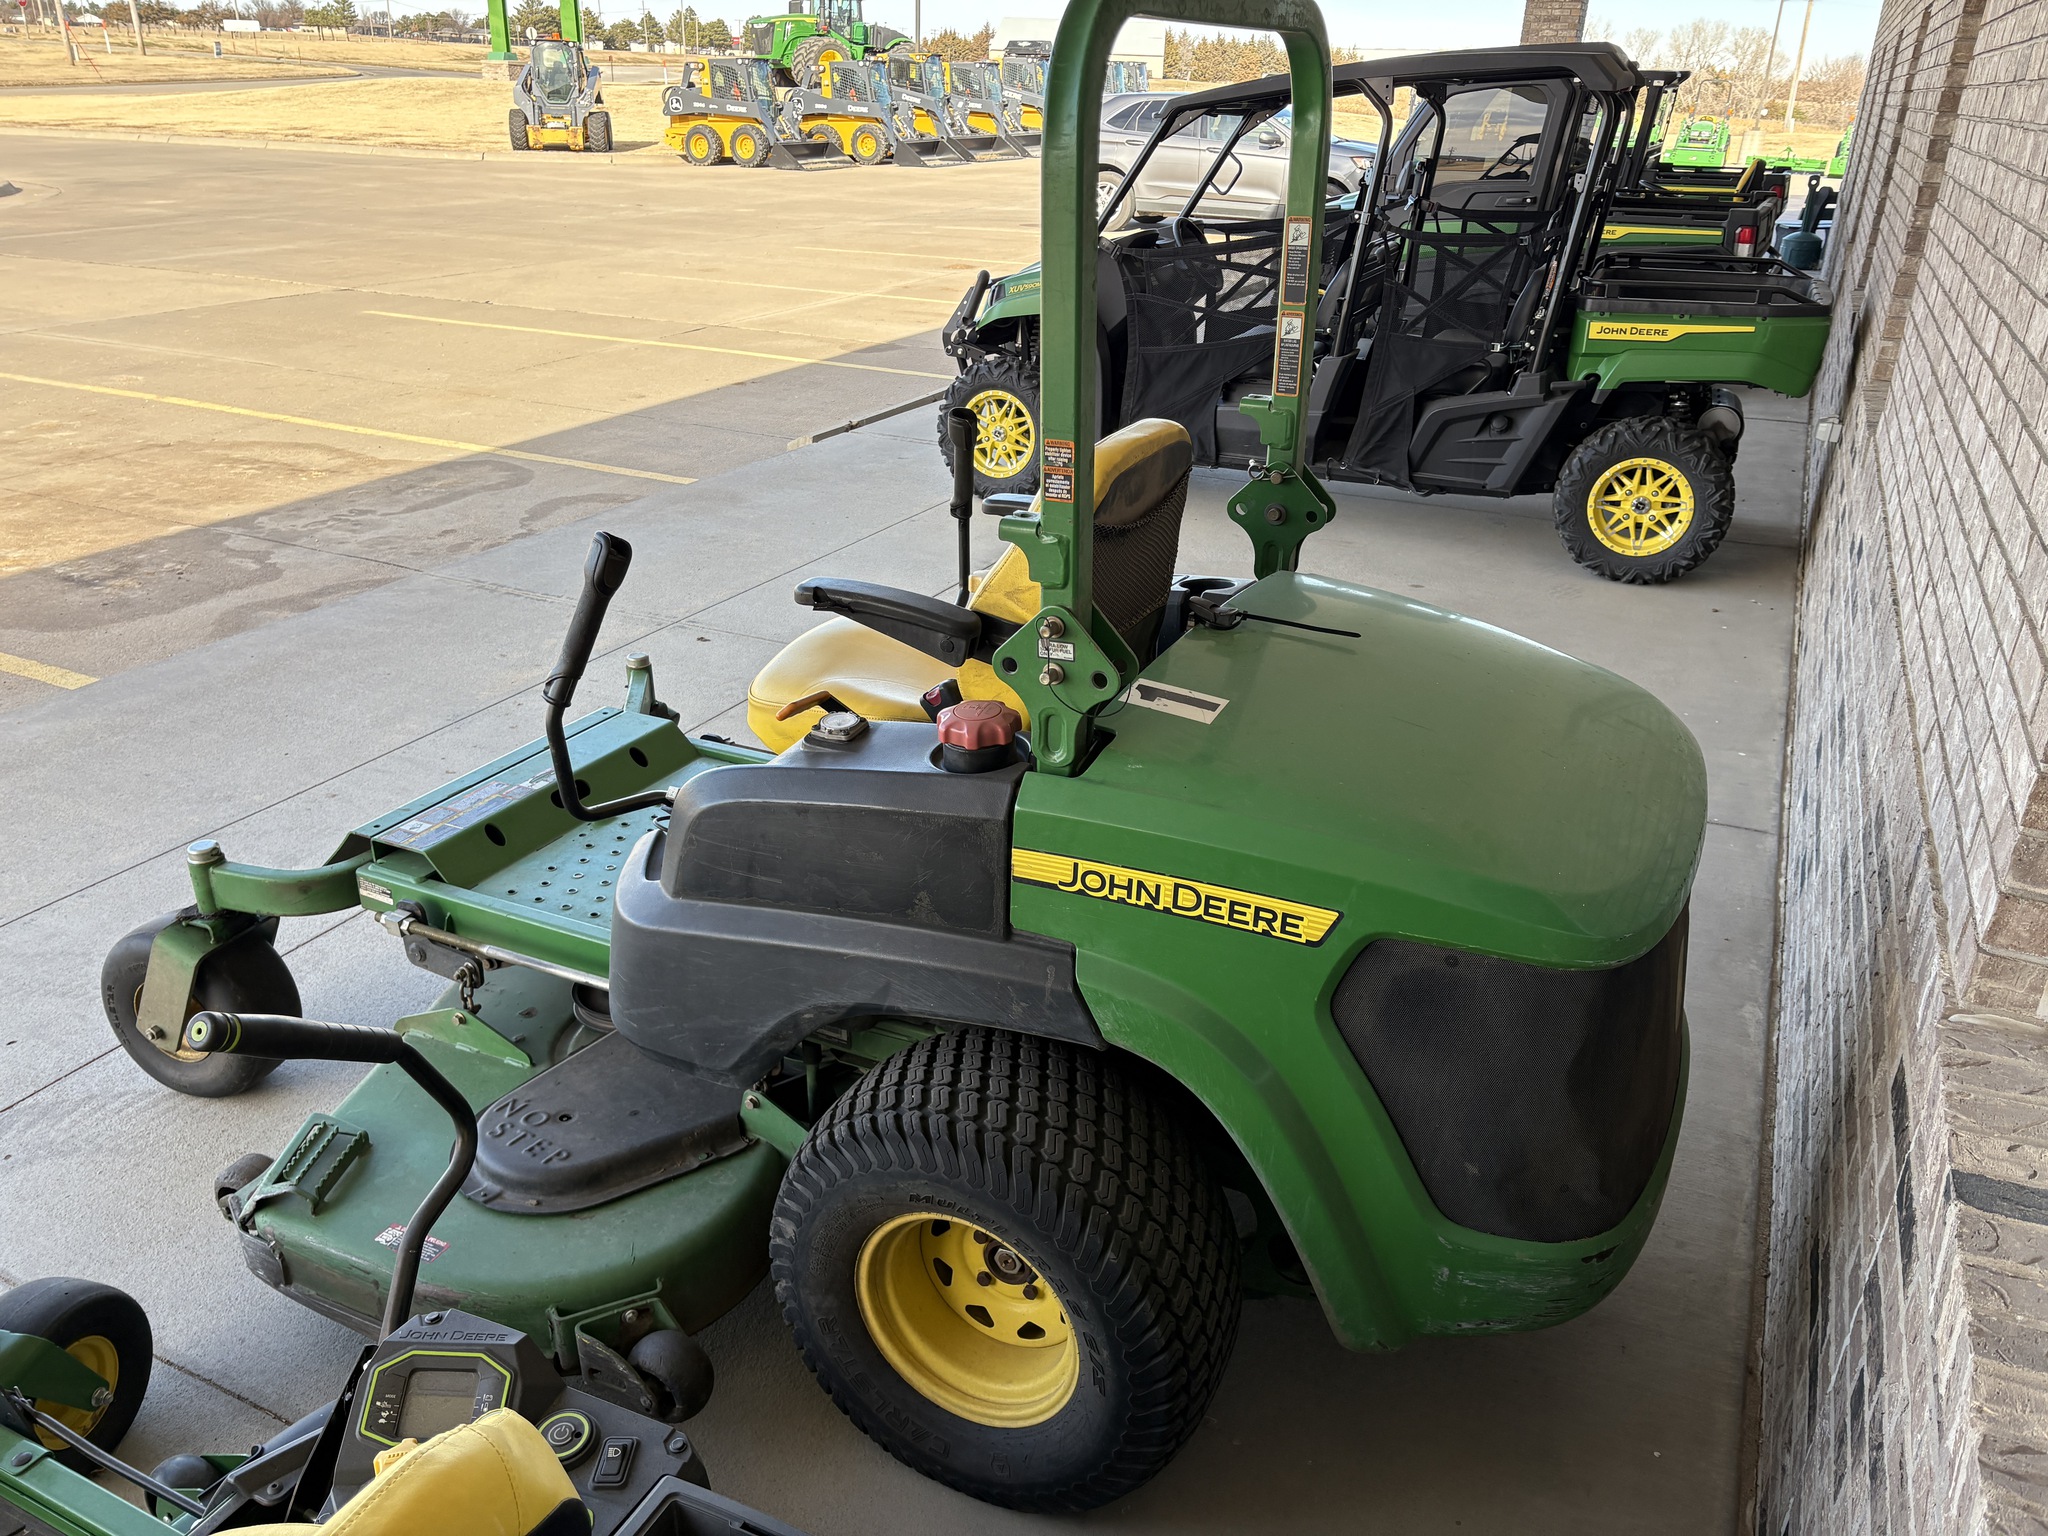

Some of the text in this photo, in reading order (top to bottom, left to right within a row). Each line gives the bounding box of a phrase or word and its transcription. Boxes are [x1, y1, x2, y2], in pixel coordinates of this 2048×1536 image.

[1596, 326, 1669, 337] JOHN DEERE
[1058, 862, 1305, 938] JOHN DEERE
[493, 1098, 550, 1127] NO
[486, 1122, 570, 1164] STEP
[909, 1193, 1008, 1234] MULTI
[399, 1329, 509, 1341] JOHN DEERE
[817, 1314, 950, 1460] CARLSTAR
